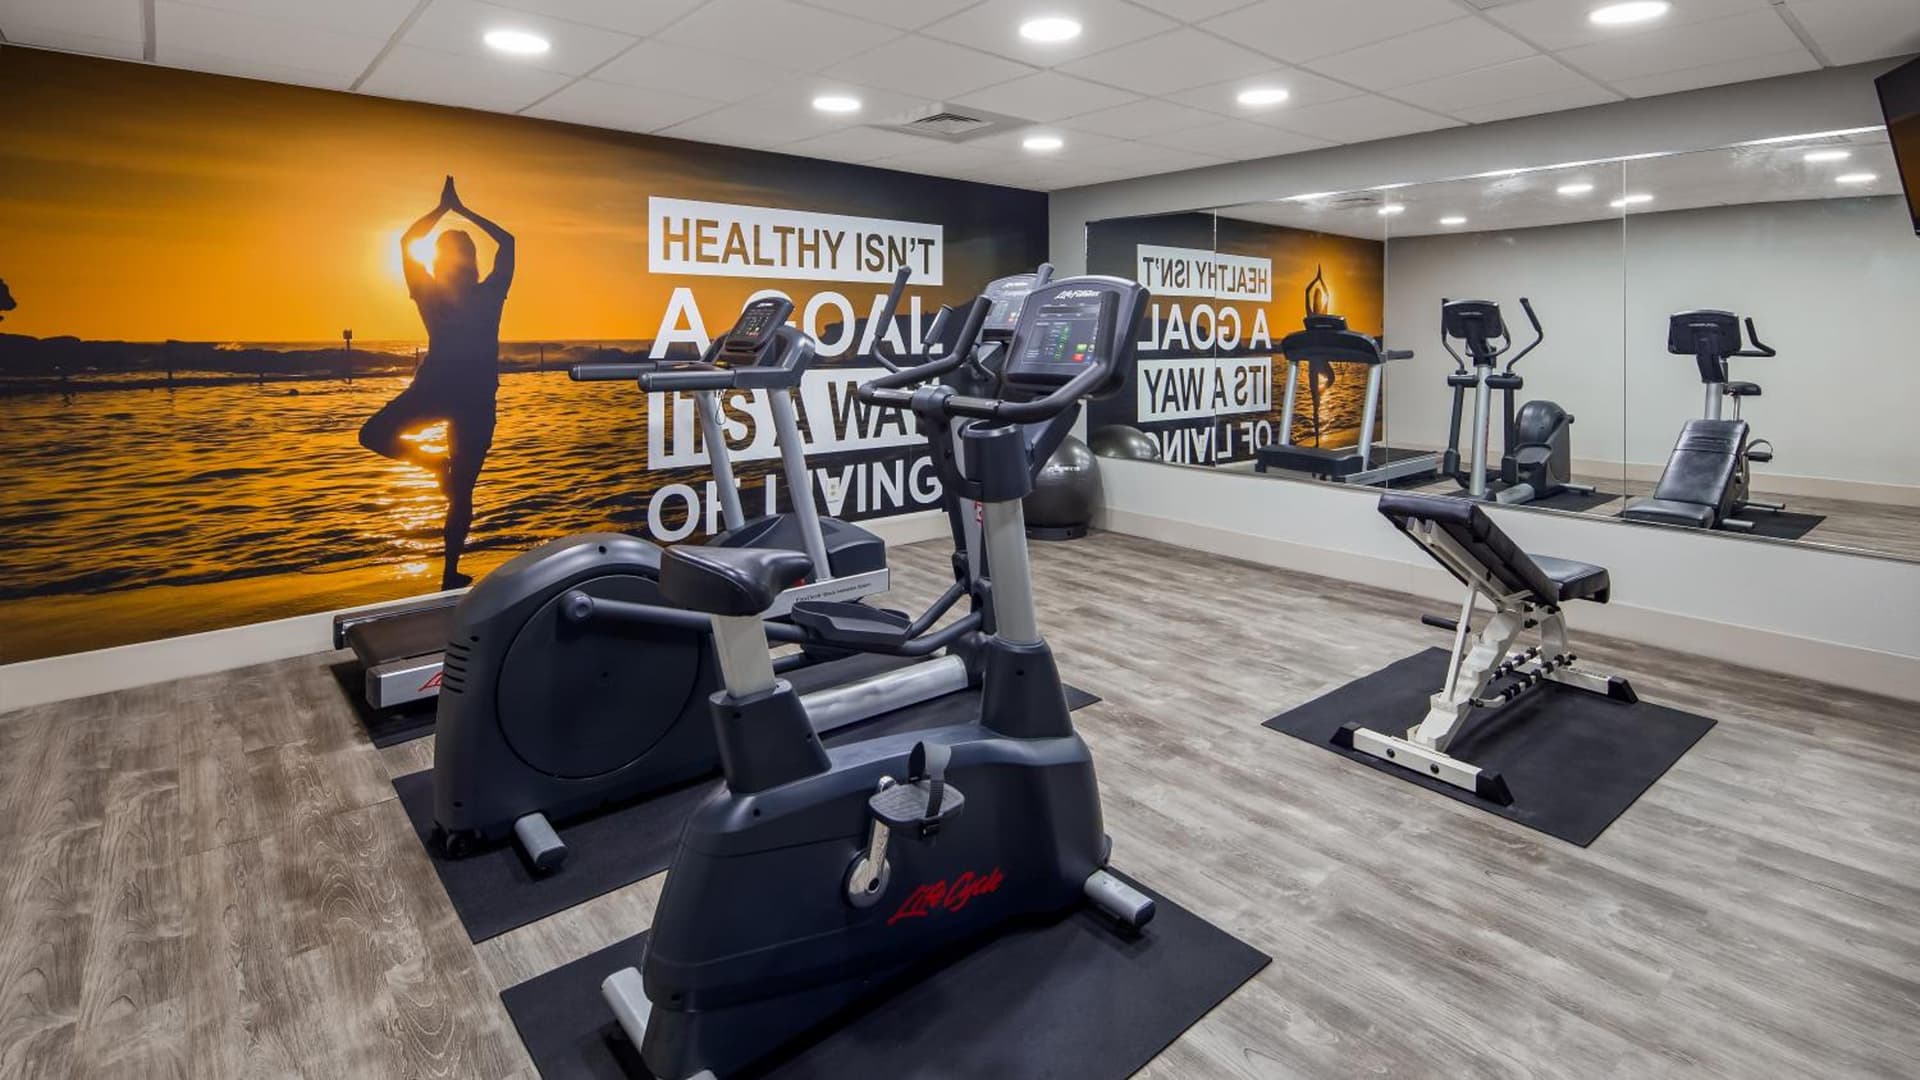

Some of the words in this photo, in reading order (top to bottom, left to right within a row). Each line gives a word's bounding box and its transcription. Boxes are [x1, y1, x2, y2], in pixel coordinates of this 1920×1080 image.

[662, 216, 845, 270] HEALTHY
[856, 231, 936, 275] ISN'T
[648, 287, 712, 359] A
